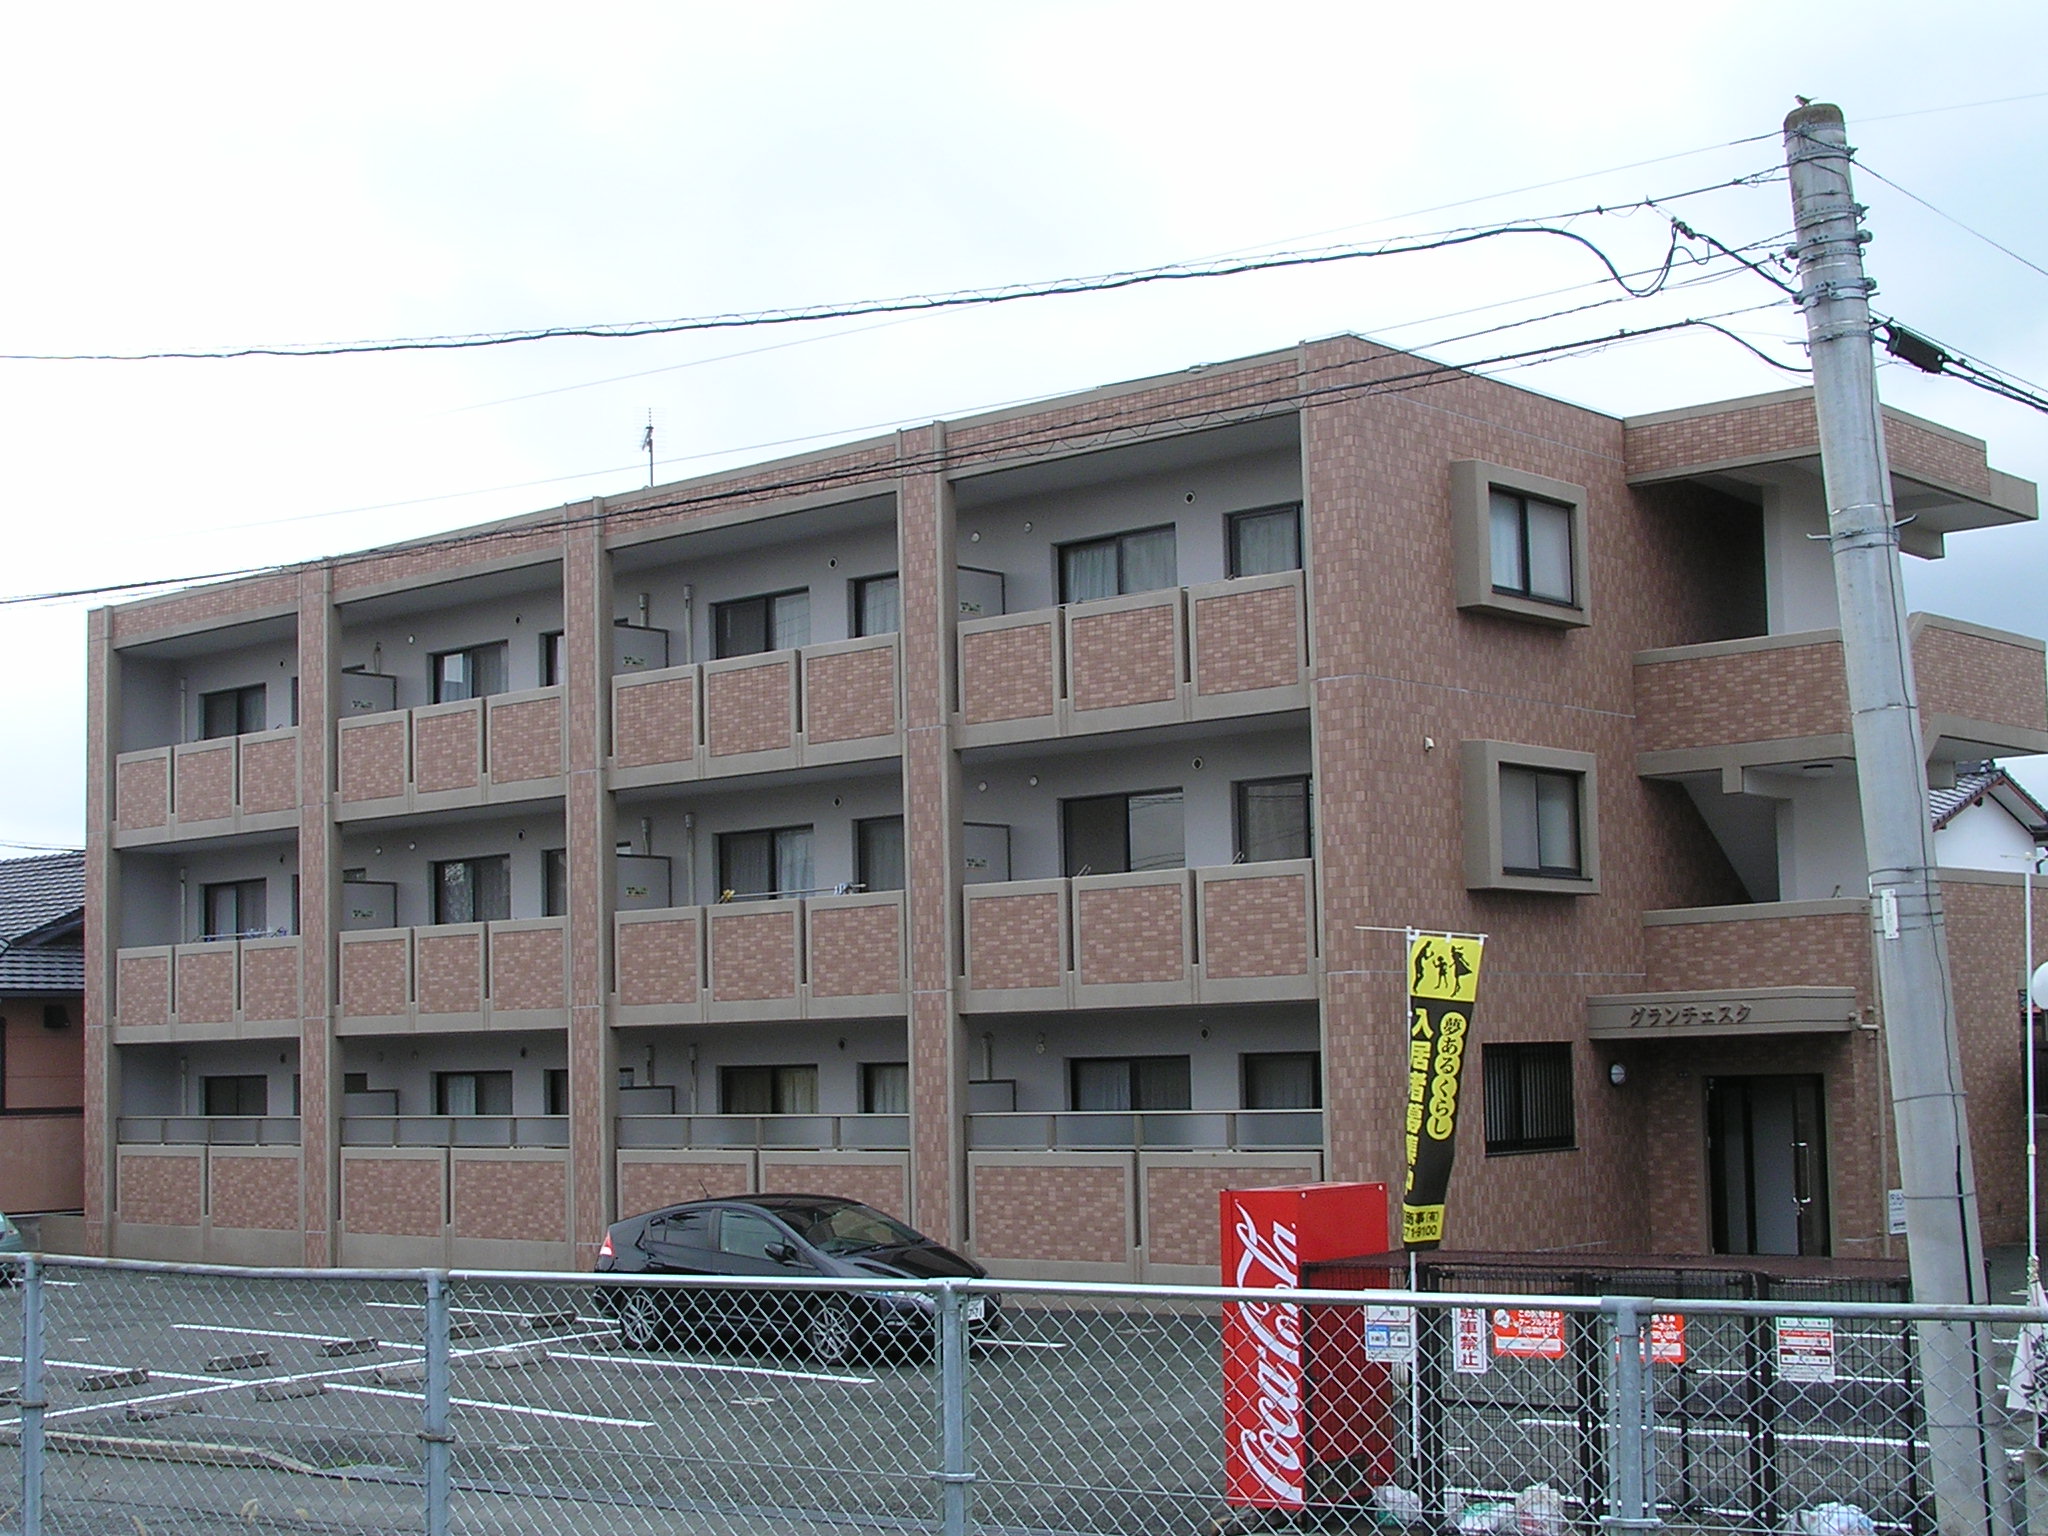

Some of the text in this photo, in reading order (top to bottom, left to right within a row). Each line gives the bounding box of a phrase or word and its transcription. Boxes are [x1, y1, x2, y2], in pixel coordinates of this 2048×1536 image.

[1434, 1017, 1463, 1136] 夢あるくらし
[1235, 1199, 1303, 1501] Coca-Cola
[1460, 1307, 1479, 1366] 駐車禁止
